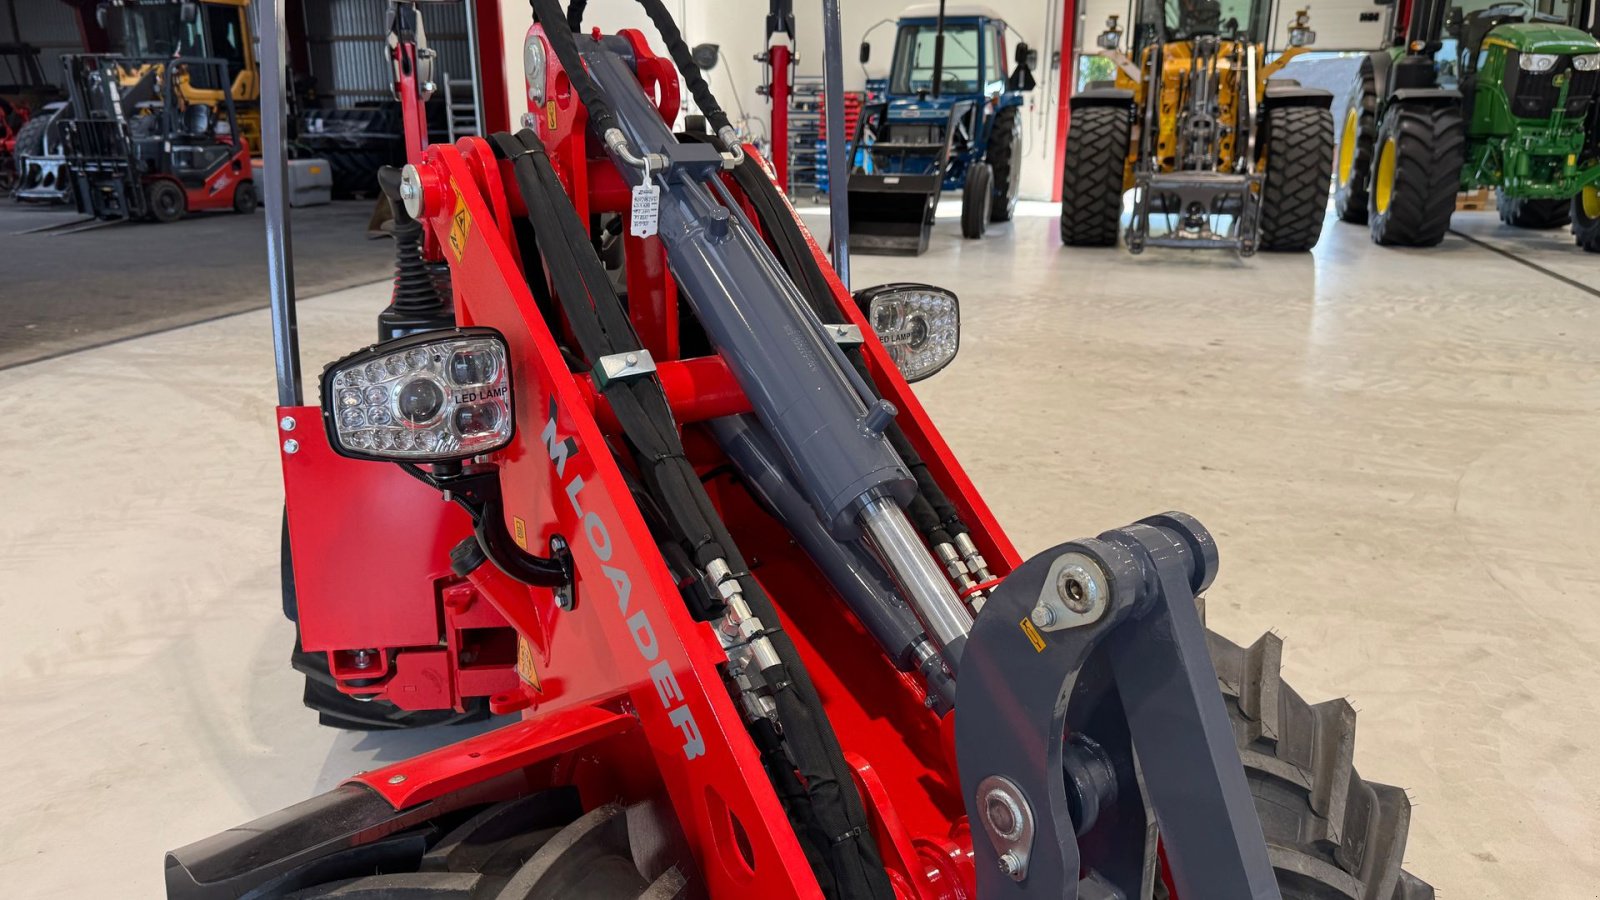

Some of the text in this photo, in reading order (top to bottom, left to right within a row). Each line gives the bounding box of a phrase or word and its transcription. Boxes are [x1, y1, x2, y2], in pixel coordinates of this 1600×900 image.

[879, 332, 911, 343] ED LAMP
[455, 386, 508, 404] LED LAMP
